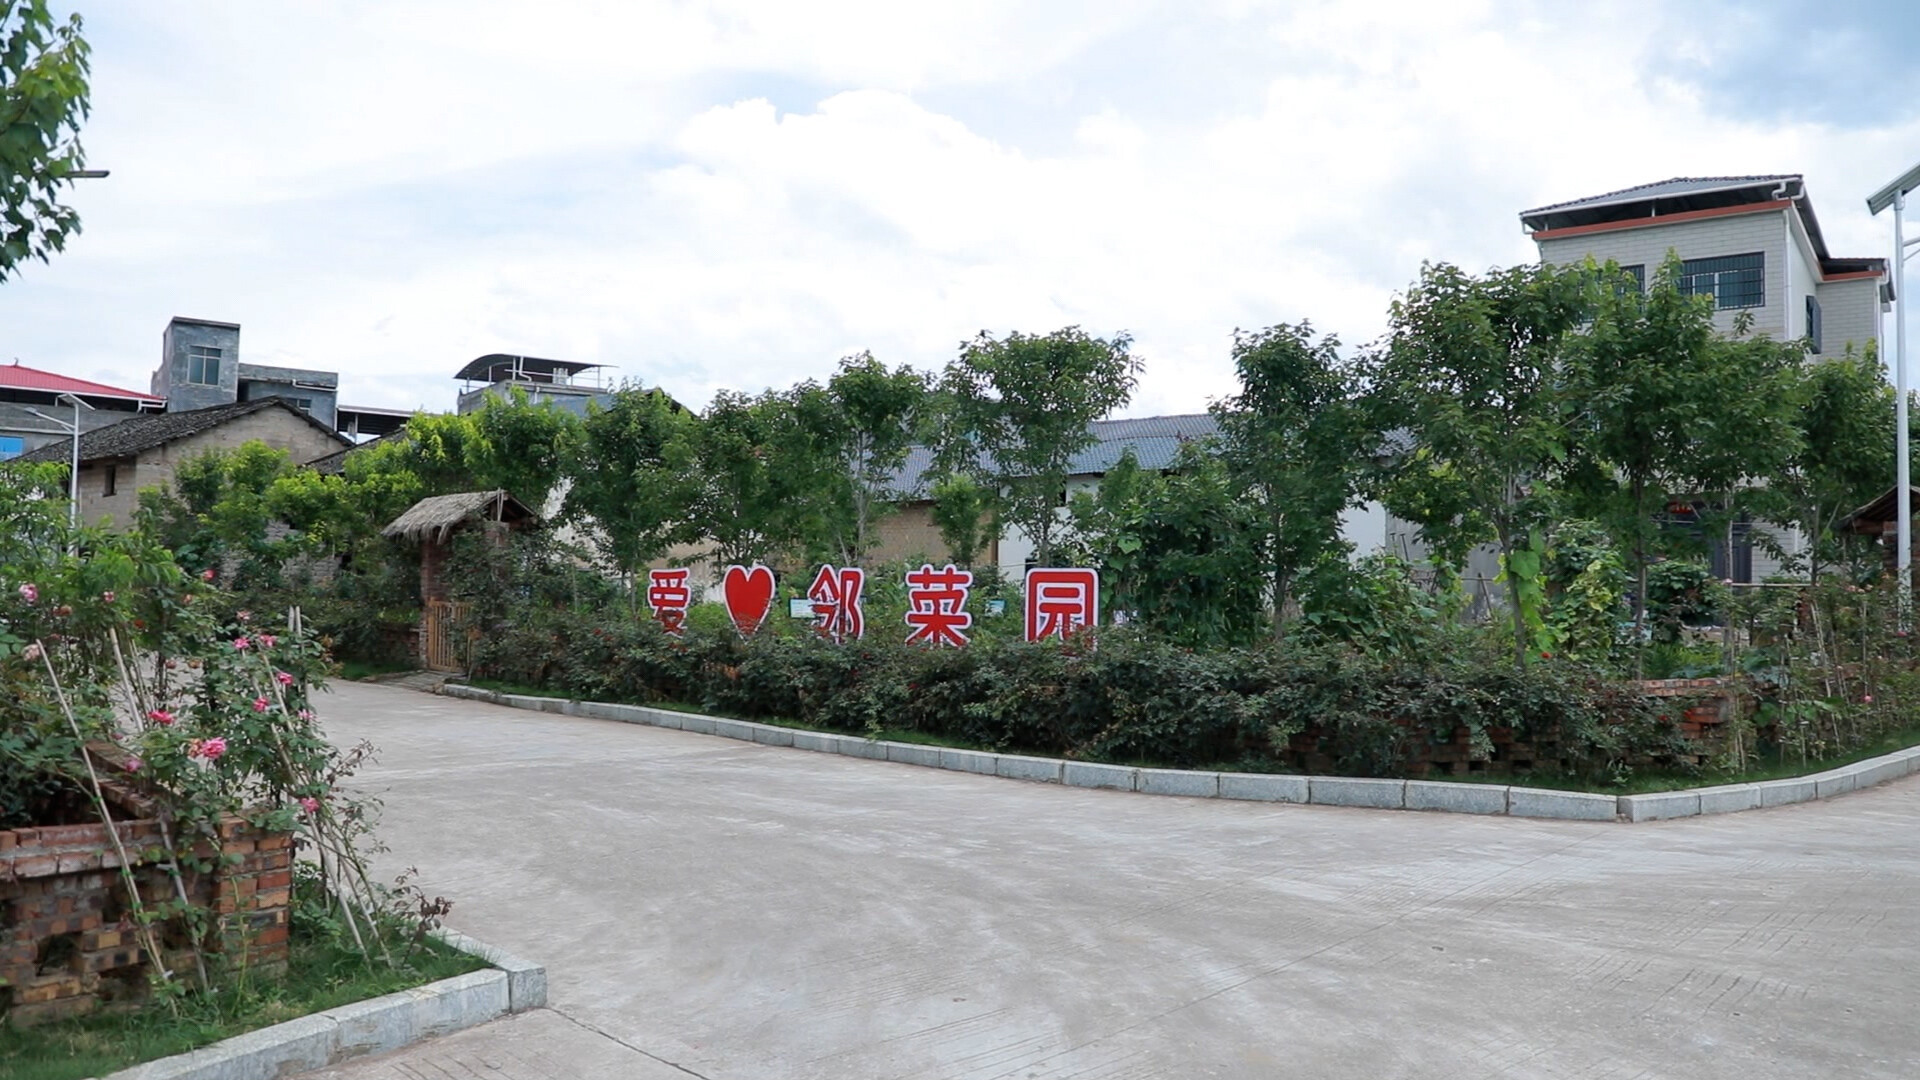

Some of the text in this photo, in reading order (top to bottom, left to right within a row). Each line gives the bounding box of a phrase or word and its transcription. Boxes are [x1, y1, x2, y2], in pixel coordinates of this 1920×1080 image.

[649, 564, 1099, 655] 爱 邻菜园
